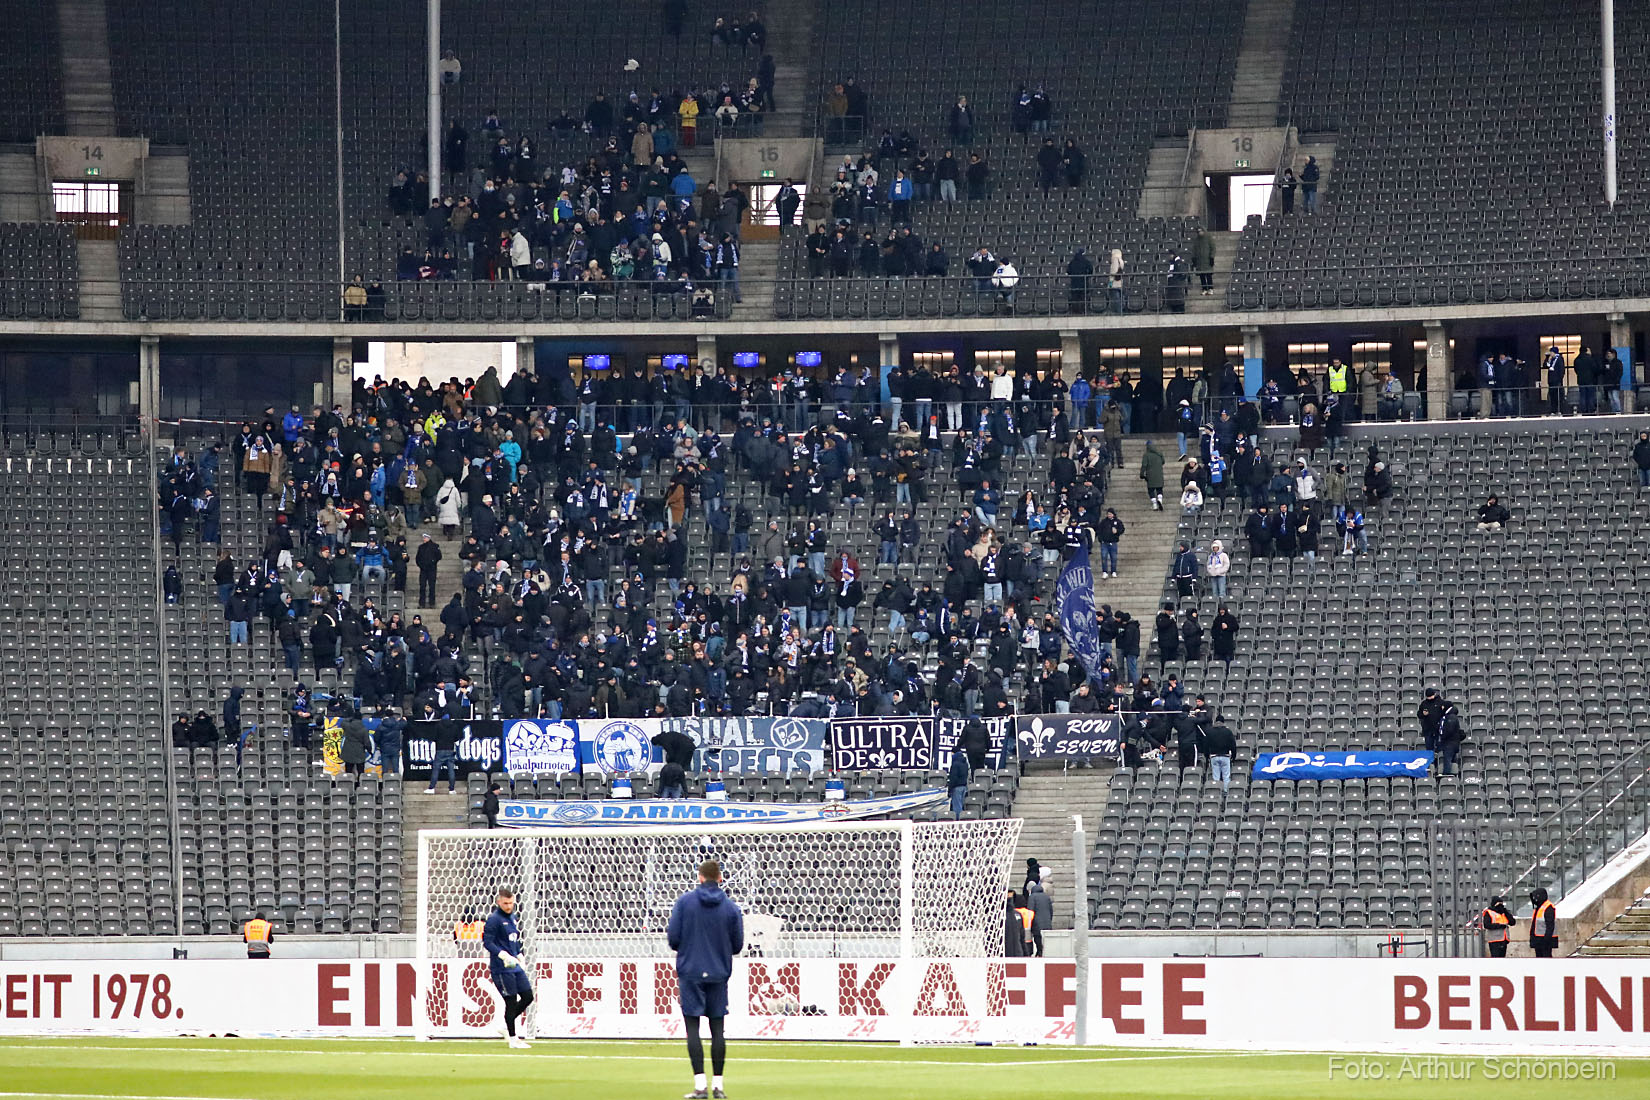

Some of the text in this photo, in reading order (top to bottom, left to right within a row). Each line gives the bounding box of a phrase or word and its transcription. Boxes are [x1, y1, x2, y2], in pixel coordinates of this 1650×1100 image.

[82, 145, 104, 160] 14
[1232, 137, 1253, 152] 16
[758, 147, 779, 162] 15
[1429, 342, 1443, 359] G
[336, 358, 350, 375] G
[699, 357, 715, 375] G
[1067, 719, 1112, 734] ROW
[408, 725, 501, 770] unrdogs
[1055, 739, 1117, 754] SEVEN
[691, 748, 812, 778] SPECTS
[837, 750, 868, 768] DE
[896, 748, 930, 767] LIS
[0, 973, 184, 1020] EIT 1978.
[317, 962, 681, 1027] EINSEI
[1393, 975, 1650, 1033] BERLIN
[1044, 1021, 1076, 1039] 24
